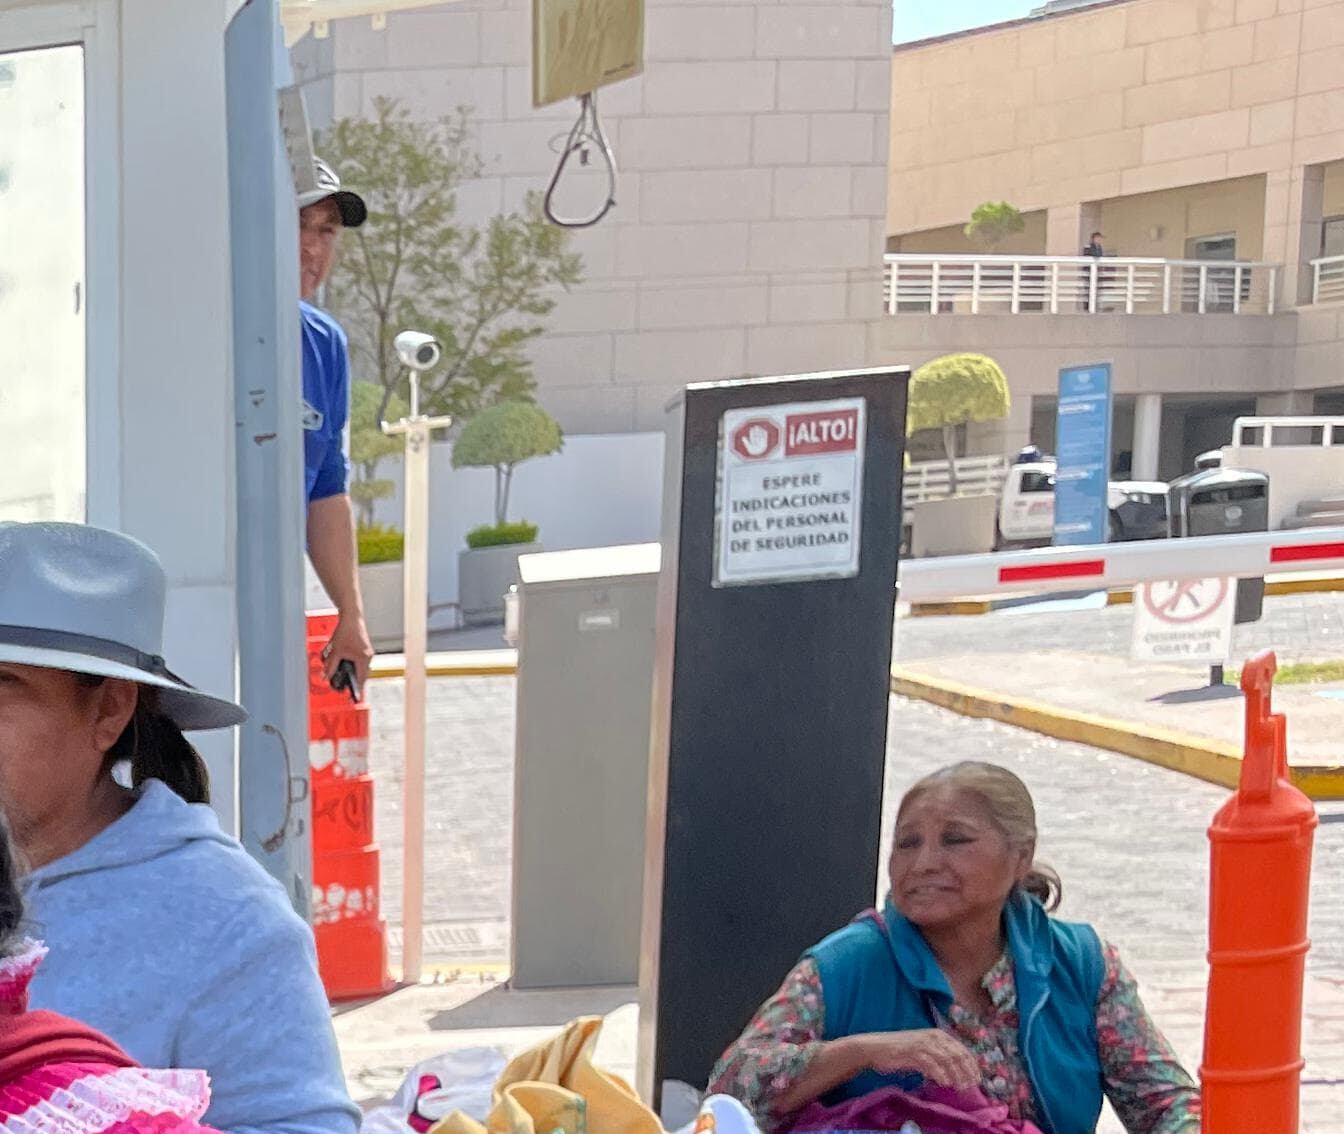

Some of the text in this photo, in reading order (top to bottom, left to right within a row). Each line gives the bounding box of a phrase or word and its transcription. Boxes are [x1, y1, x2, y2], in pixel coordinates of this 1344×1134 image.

[789, 417, 854, 448] ¡ALTO!
[763, 473, 822, 490] ESPERE
[732, 491, 850, 513] INDICACIONES
[732, 511, 849, 533] DEL PERSONAL
[730, 532, 849, 553] DE SEGURIDAD
